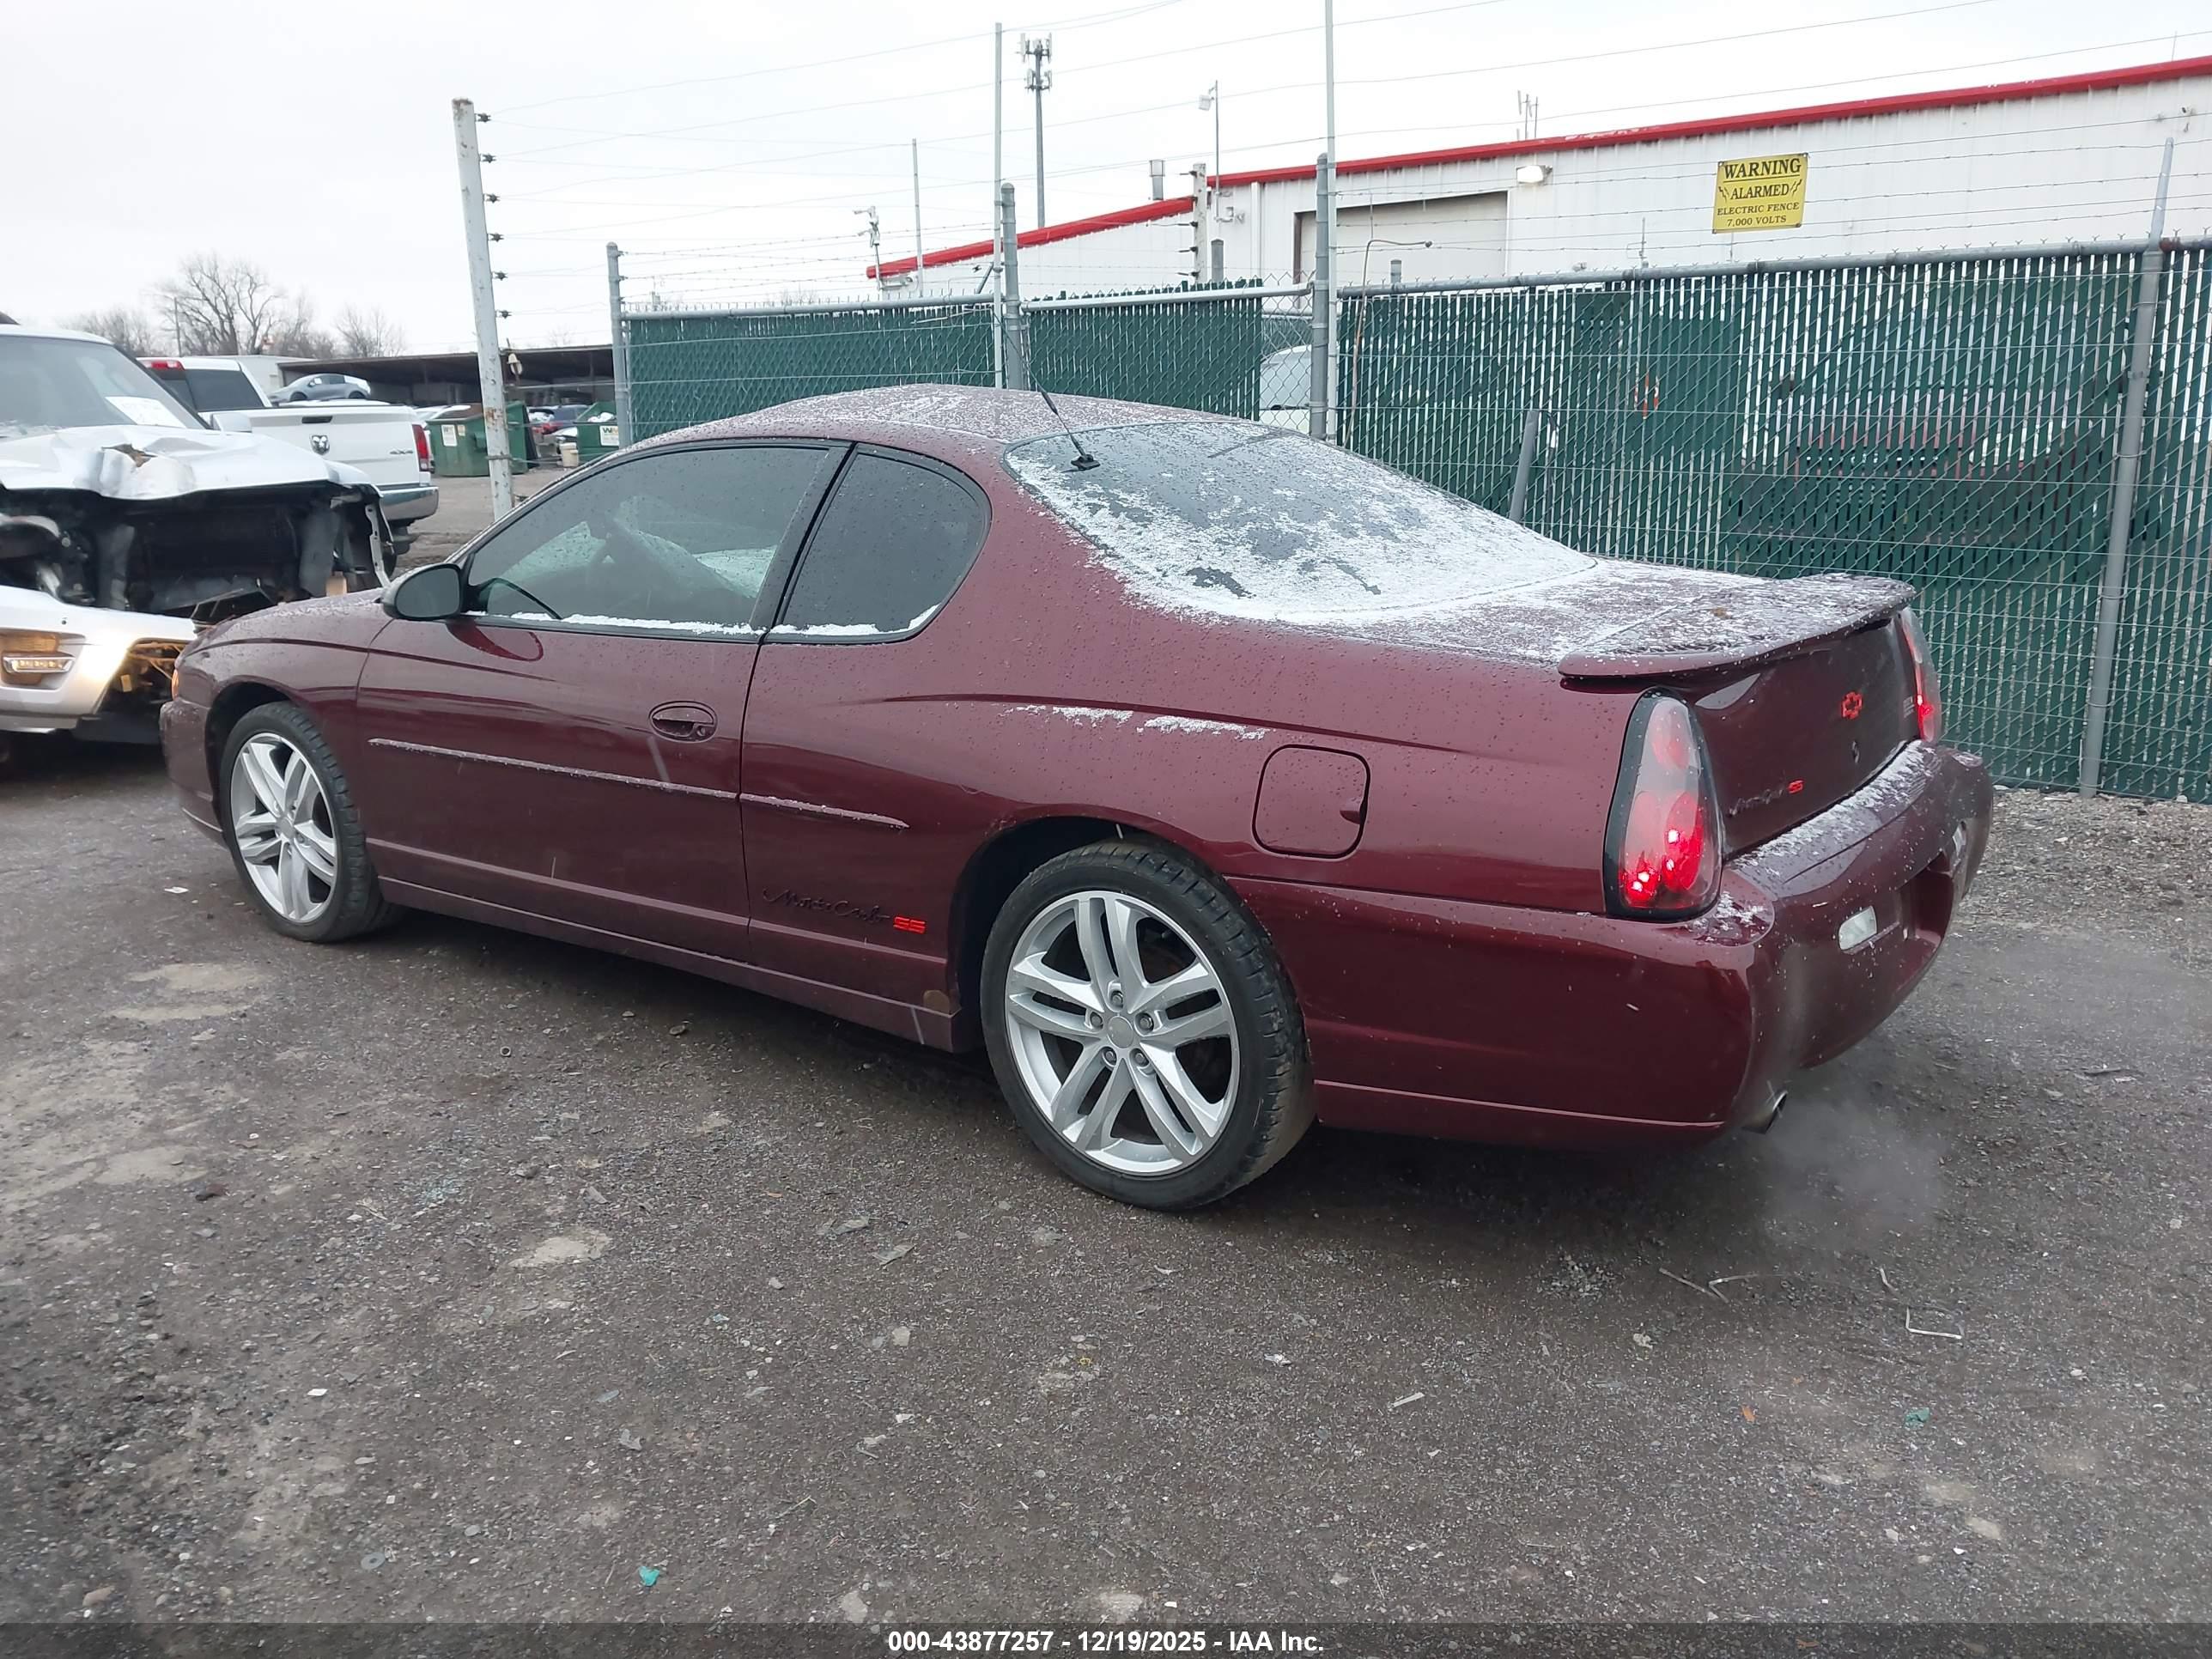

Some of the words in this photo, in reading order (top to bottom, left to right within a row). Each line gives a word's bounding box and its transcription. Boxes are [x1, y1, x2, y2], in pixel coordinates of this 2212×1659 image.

[1723, 157, 1802, 179] WARNING
[1730, 183, 1790, 200] ALARMED
[1717, 204, 1765, 216] ELECTRIC
[1767, 202, 1800, 212] FENCE
[1755, 215, 1787, 224] VOLTS
